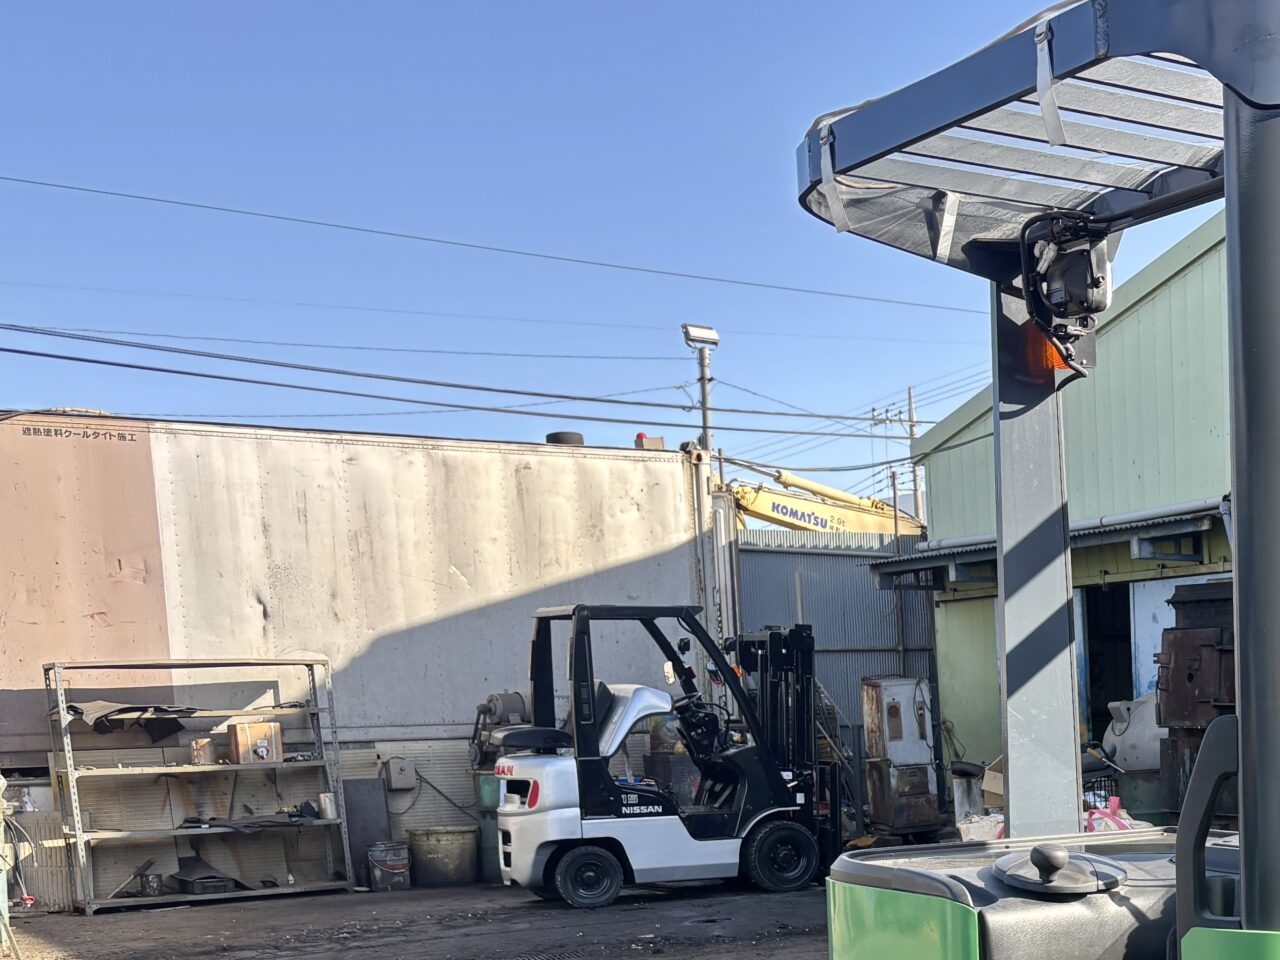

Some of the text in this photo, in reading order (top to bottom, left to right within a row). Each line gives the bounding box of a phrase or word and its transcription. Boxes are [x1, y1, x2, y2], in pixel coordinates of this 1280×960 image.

[22, 427, 137, 442] 遮熱塗料クールタイト施工
[771, 502, 828, 529] KOMATSU
[621, 805, 662, 814] NISSAN
